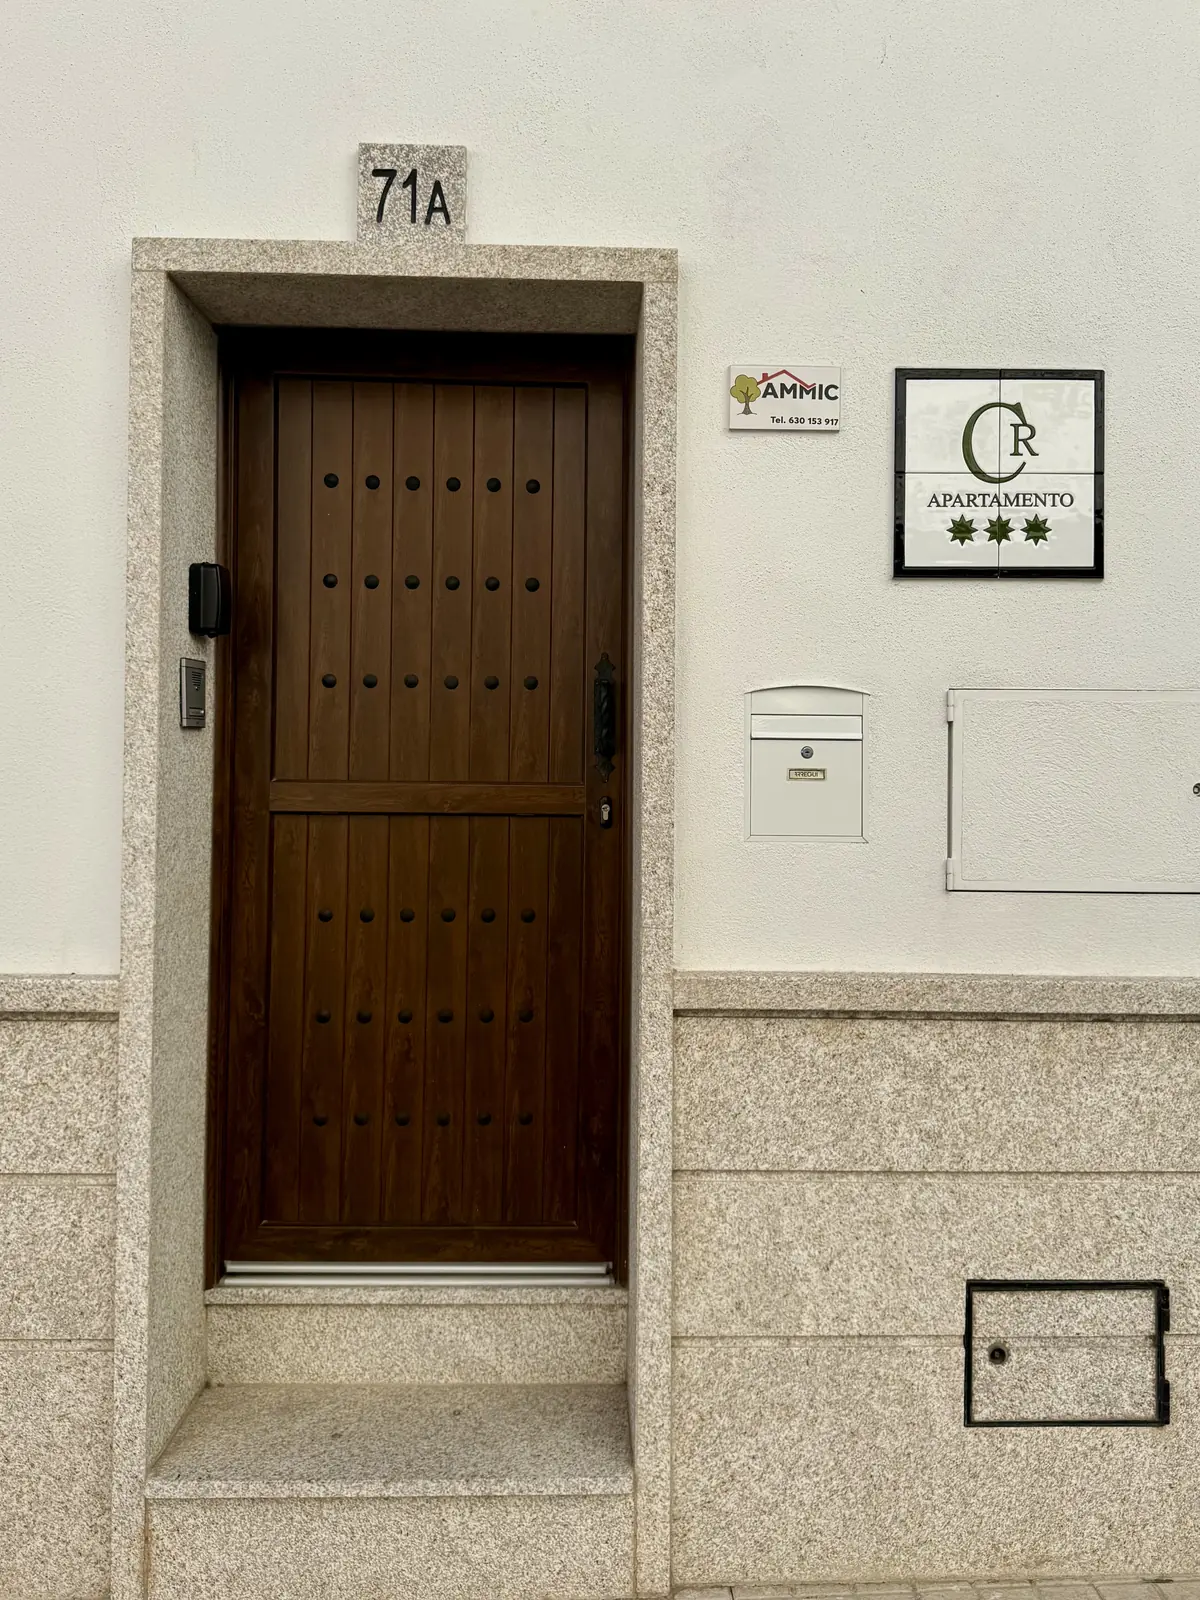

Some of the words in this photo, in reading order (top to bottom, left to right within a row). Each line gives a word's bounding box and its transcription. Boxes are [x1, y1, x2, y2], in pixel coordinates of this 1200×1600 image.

[372, 169, 451, 225] 71A
[761, 382, 839, 401] AMMIC
[770, 416, 786, 424] Tel.
[788, 416, 805, 425] 630
[808, 417, 822, 426] 153
[824, 418, 839, 426] 917
[927, 493, 1074, 508] APARTAMENTO
